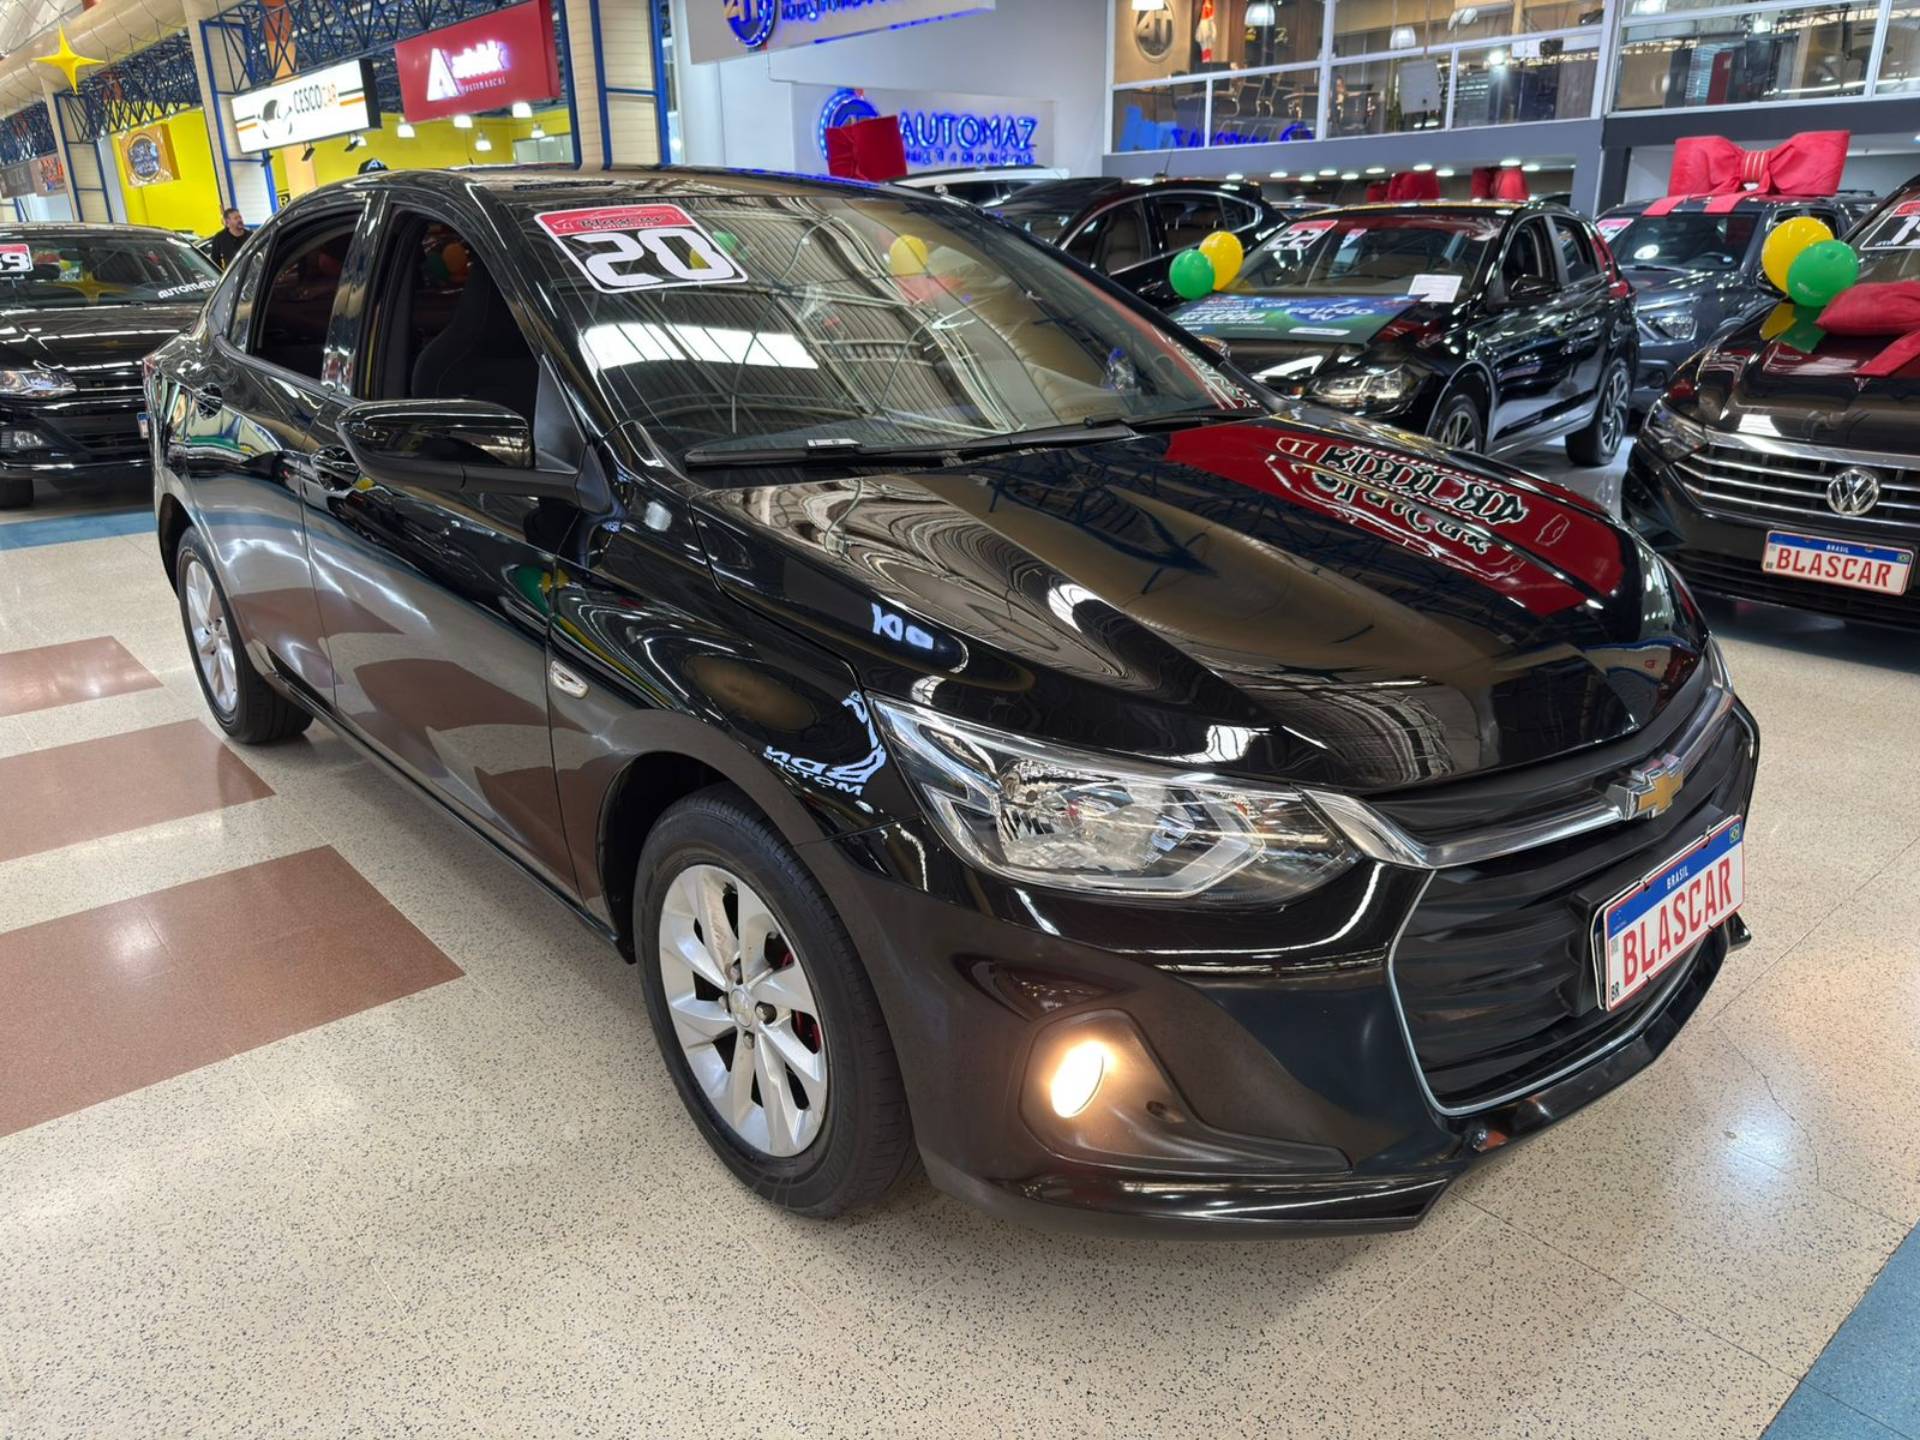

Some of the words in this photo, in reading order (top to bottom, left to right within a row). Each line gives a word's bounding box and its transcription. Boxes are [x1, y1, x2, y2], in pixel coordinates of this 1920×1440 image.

[900, 110, 1037, 150] AUTOMAZ
[571, 228, 735, 288] 20
[1776, 548, 1892, 587] BLASCAR
[1666, 865, 1689, 890] BRASIL
[1623, 857, 1733, 987] BLASCAR
